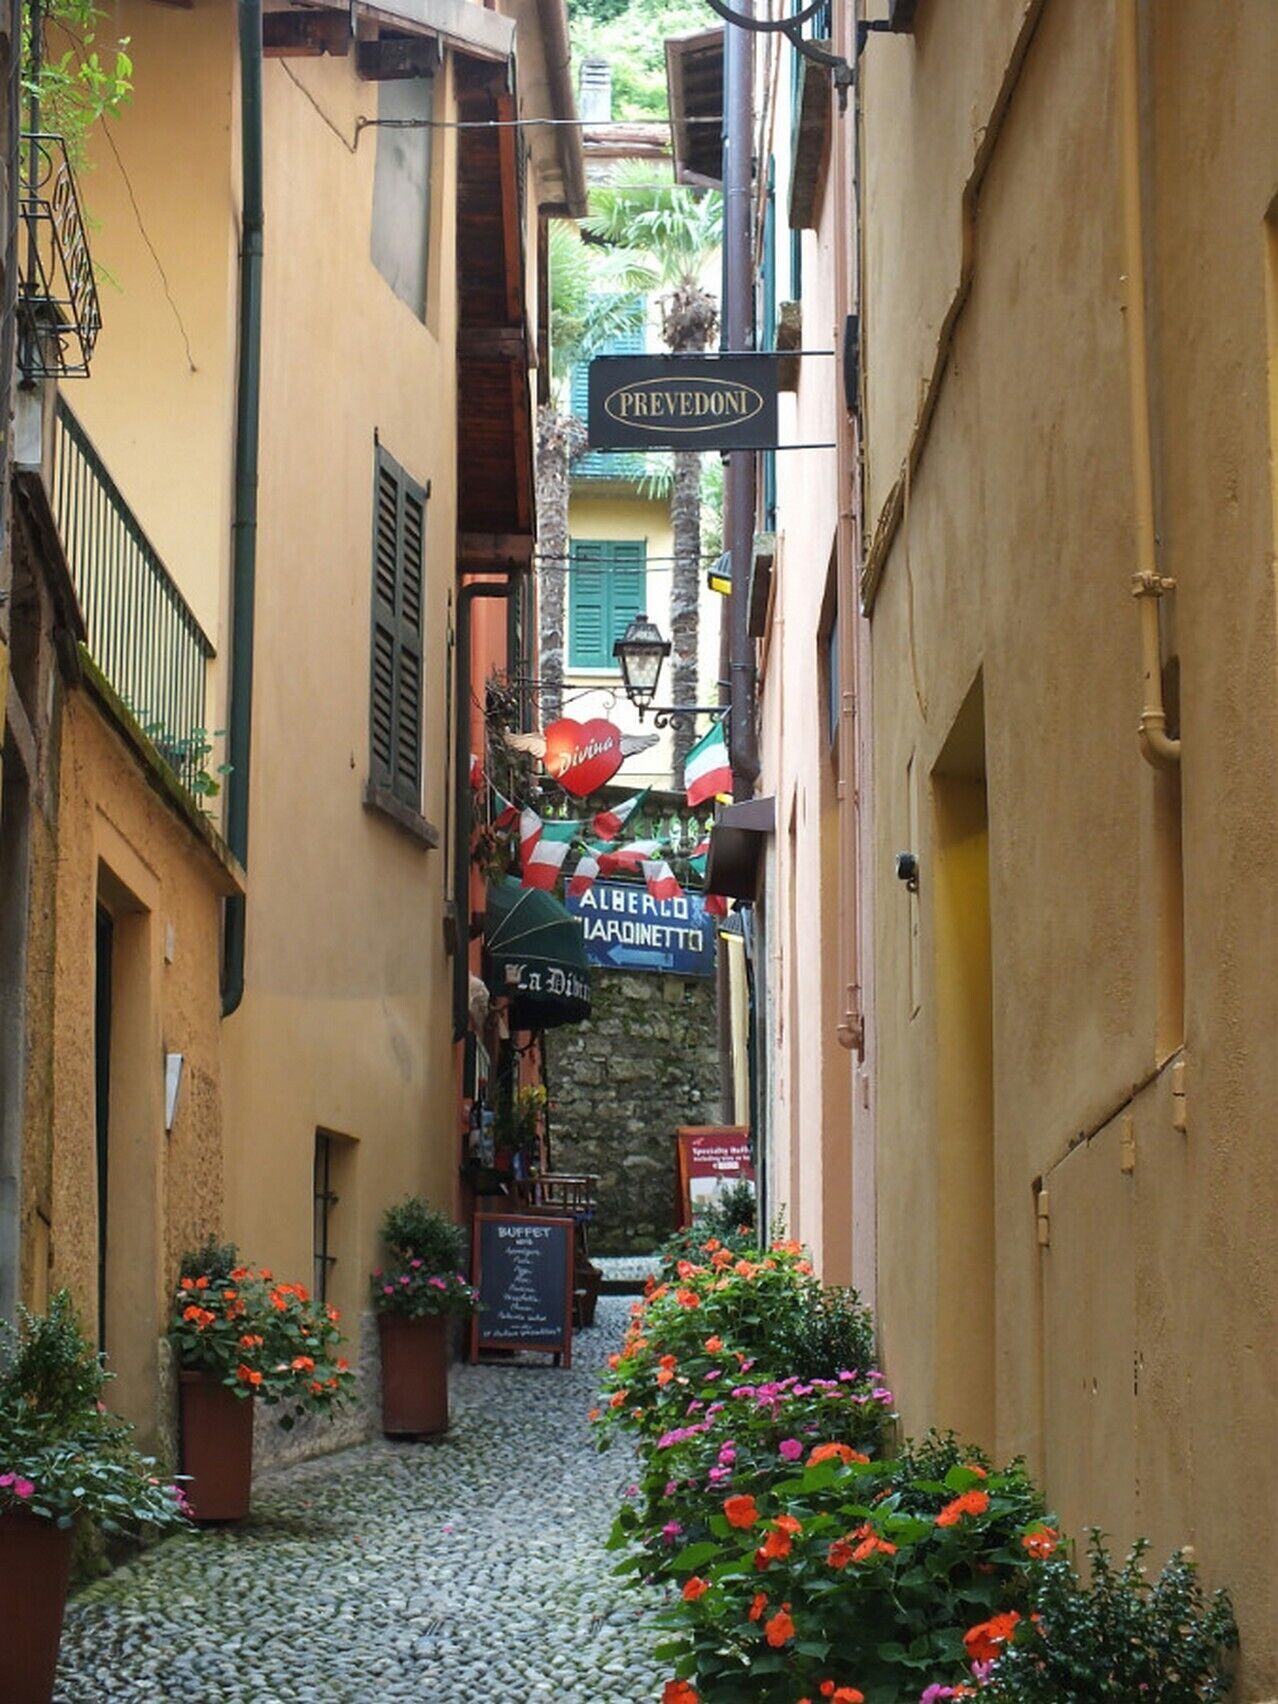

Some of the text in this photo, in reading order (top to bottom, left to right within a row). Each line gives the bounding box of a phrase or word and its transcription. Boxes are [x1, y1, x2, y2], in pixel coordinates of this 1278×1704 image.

[619, 391, 748, 417] PREVEDONI
[557, 736, 614, 778] Divina
[575, 916, 703, 952] IARDINETTO
[505, 964, 541, 991] La
[498, 1227, 552, 1238] BUFFET
